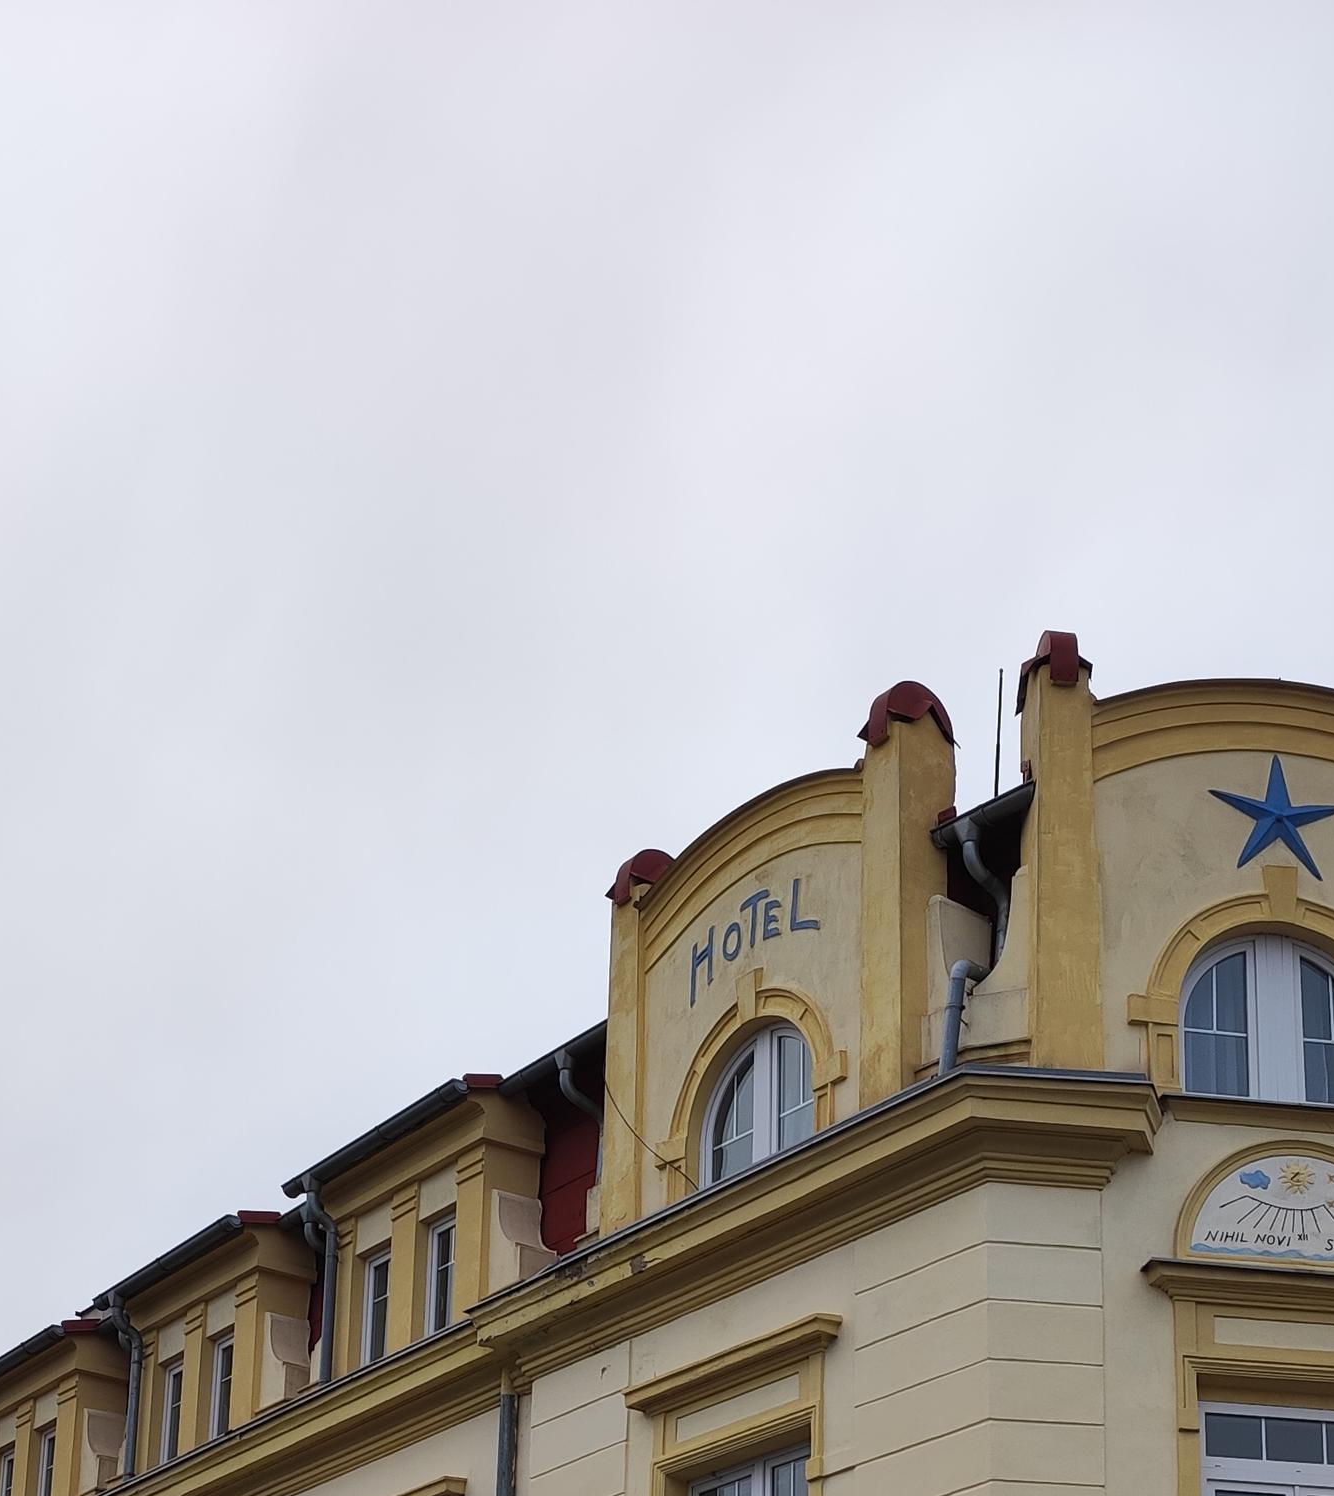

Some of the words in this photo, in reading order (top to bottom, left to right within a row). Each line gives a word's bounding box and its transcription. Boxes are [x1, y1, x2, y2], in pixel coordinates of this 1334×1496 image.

[690, 879, 820, 1008] HOTEL
[1204, 1230, 1248, 1243] NIHIL
[1254, 1234, 1291, 1247] NOVI
